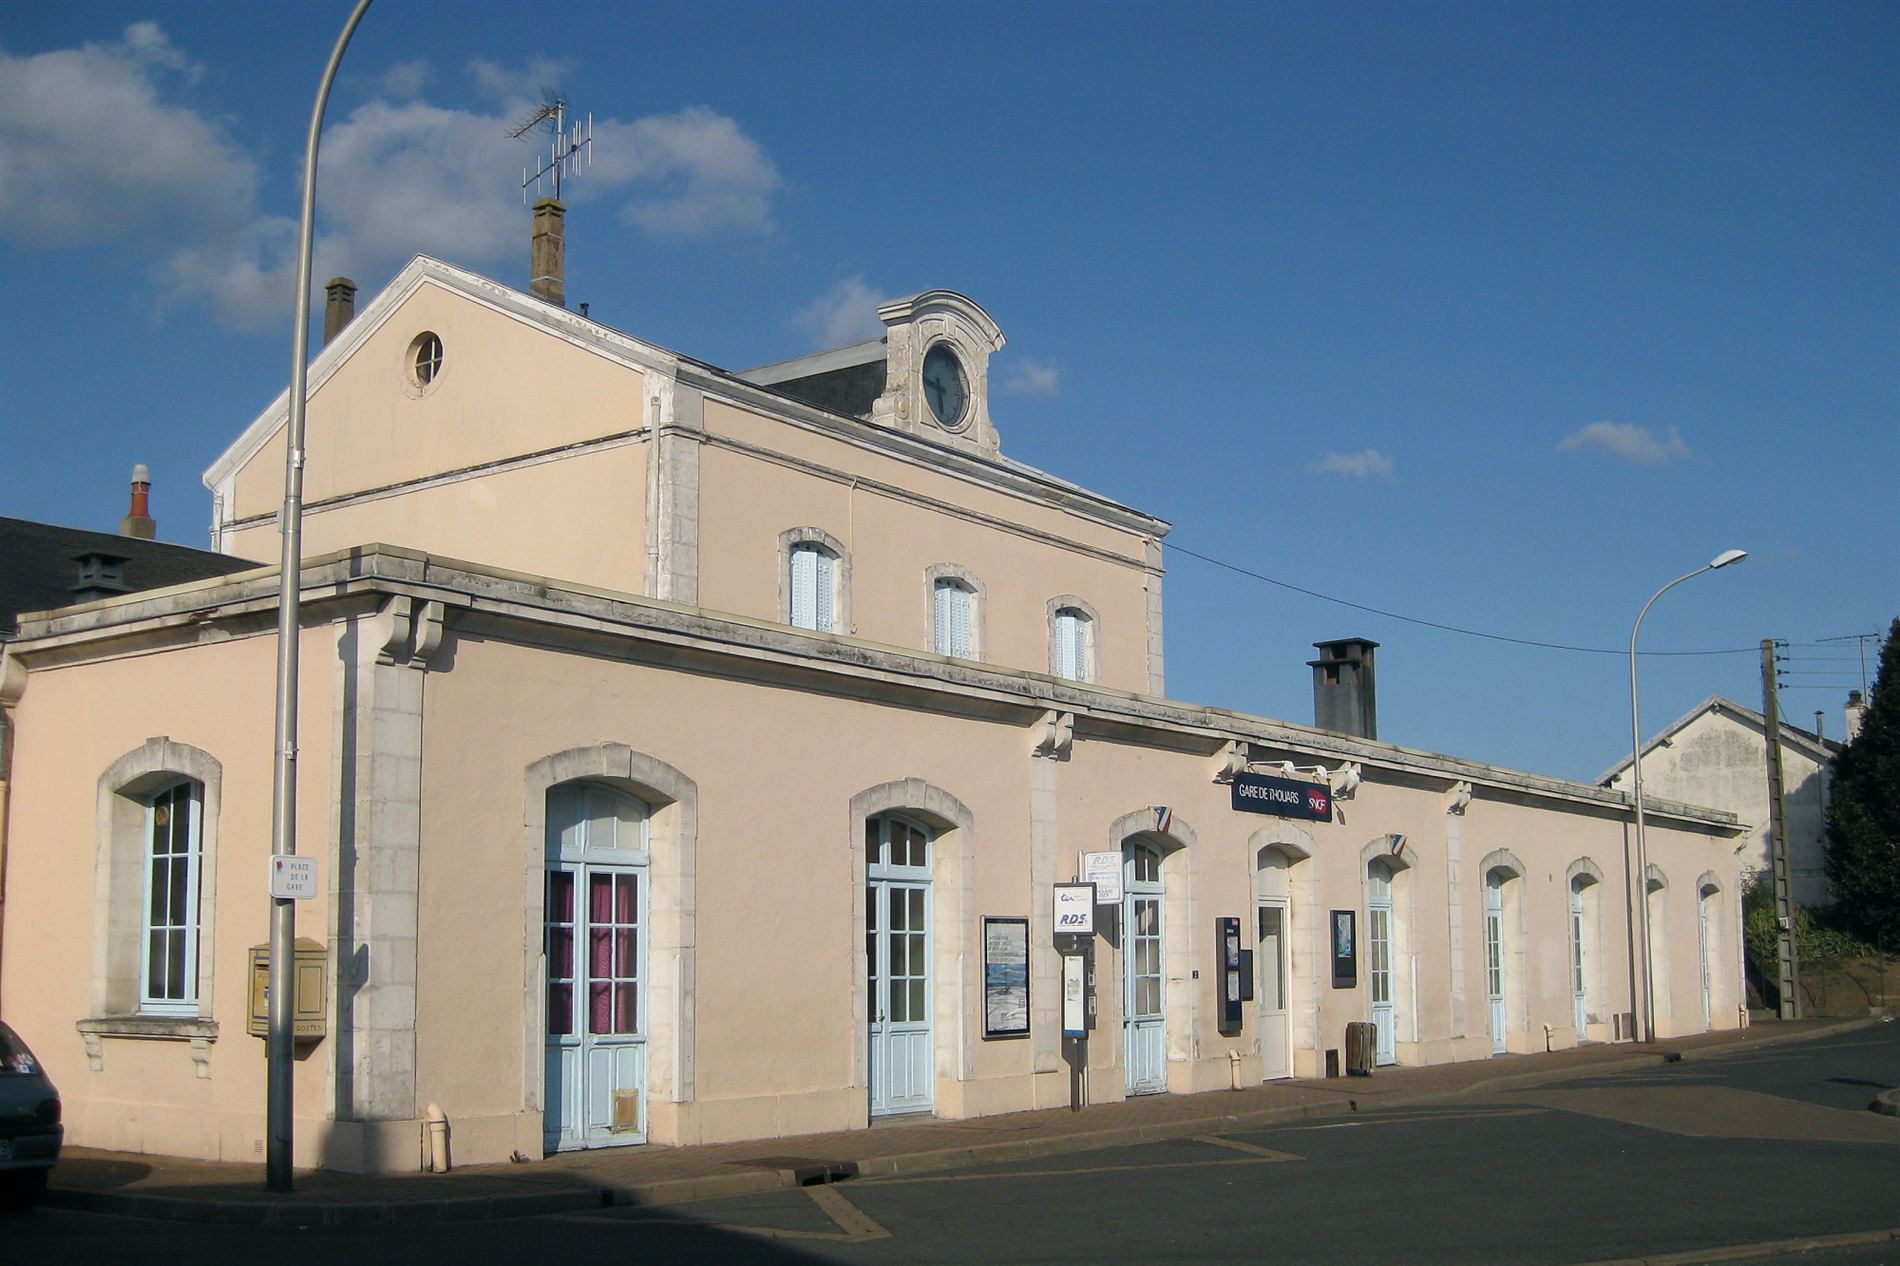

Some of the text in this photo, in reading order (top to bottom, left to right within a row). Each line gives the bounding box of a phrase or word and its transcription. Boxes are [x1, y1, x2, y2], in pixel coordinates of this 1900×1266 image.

[1239, 783, 1299, 804] GARE DE THOUARS
[1308, 797, 1327, 810] SNCF
[1093, 856, 1115, 865] RDS
[291, 863, 309, 871] PLACE
[1060, 913, 1087, 925] RDS
